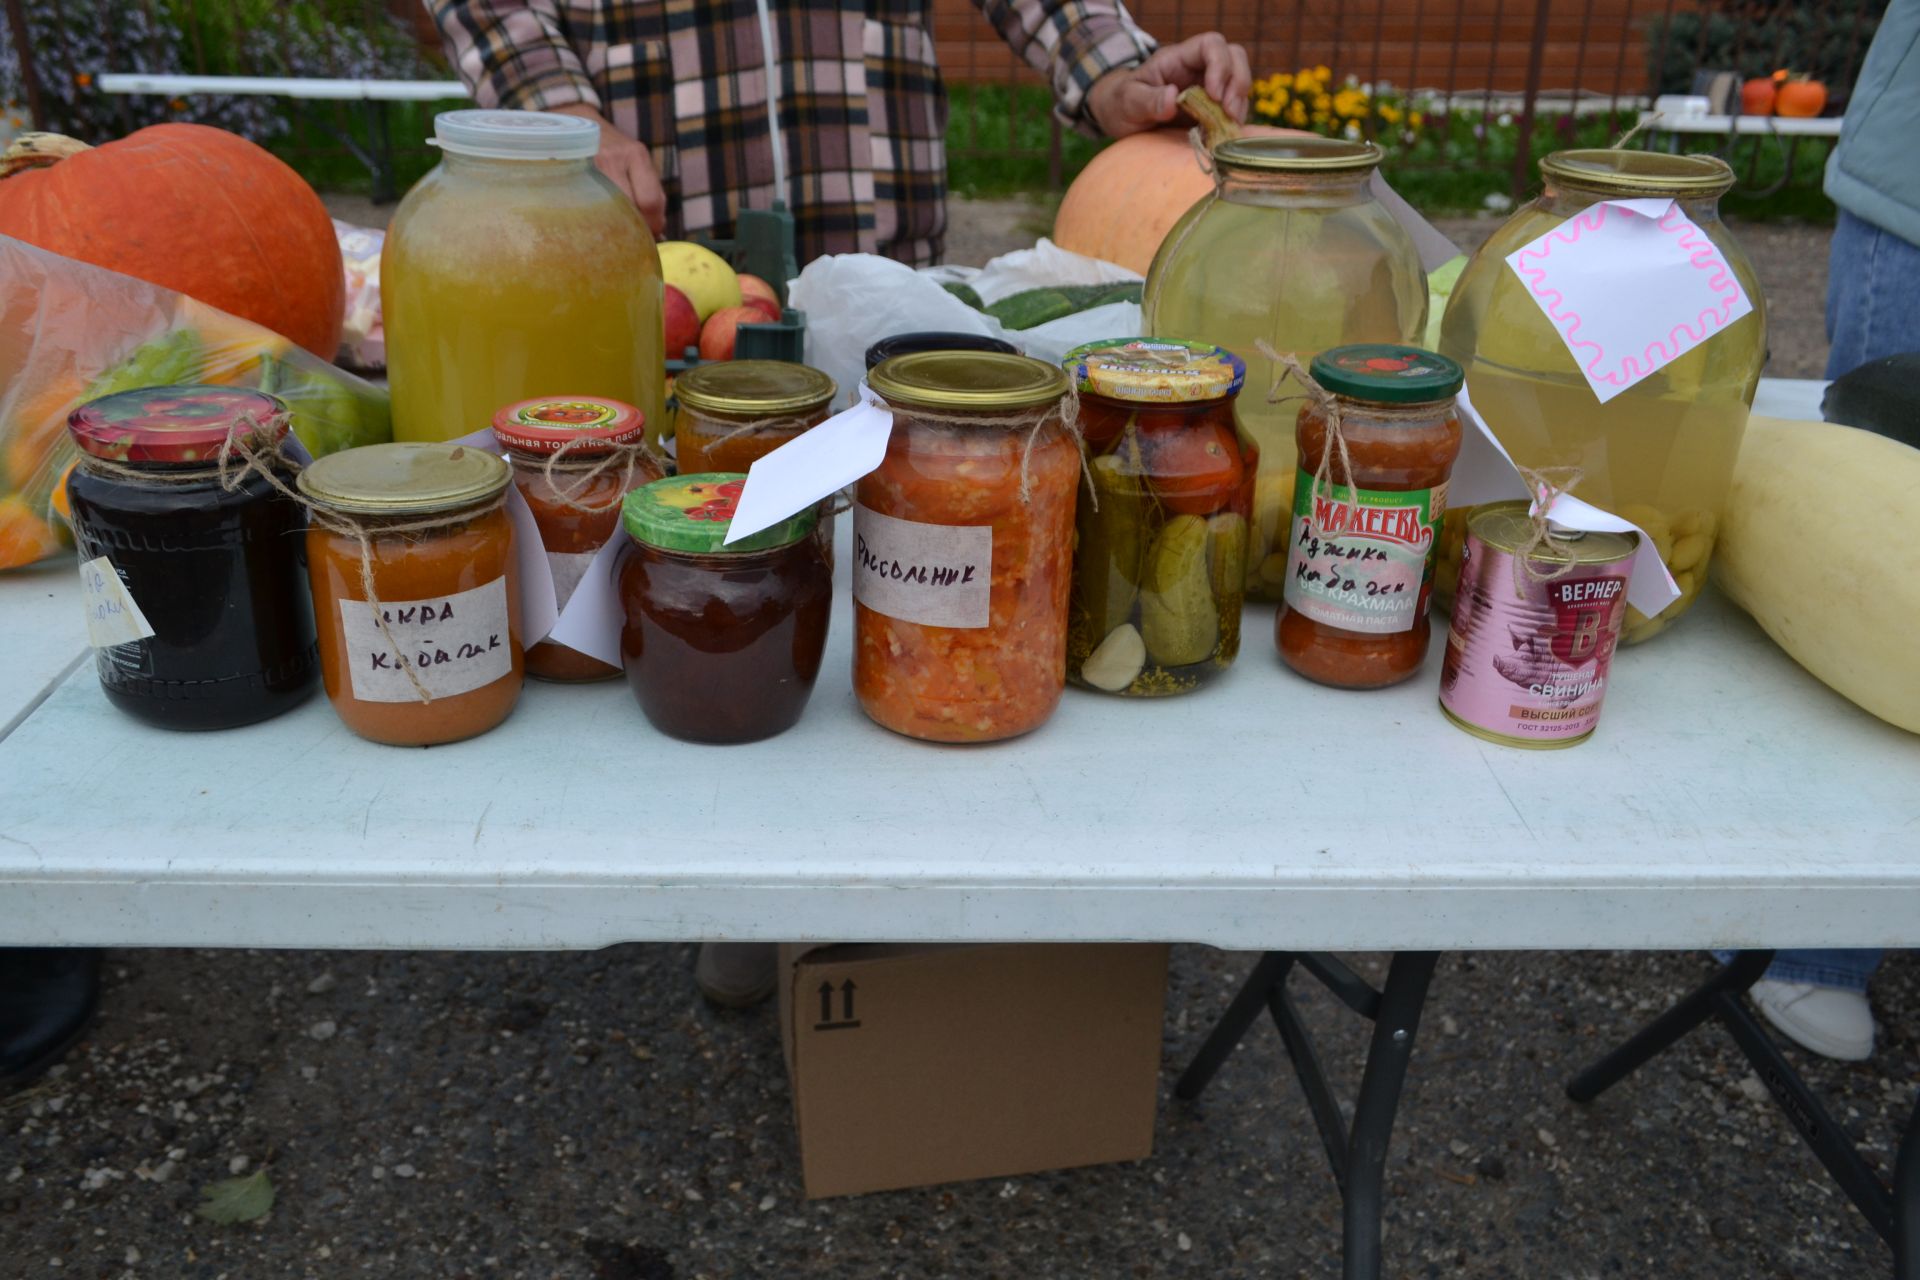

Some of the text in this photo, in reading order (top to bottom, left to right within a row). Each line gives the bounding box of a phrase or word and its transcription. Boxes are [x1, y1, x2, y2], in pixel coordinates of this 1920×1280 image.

[615, 426, 642, 443] паста
[1327, 586, 1413, 612] КРАХМАЛА
[1561, 580, 1621, 602] ВЕРНЕР
[1310, 606, 1399, 625] ТОМАТНАЯ ПАСТА
[1529, 677, 1603, 697] СВИНИНА
[1520, 706, 1576, 720] ВЫСШИЙ
[1517, 722, 1539, 732] ГОСТ
